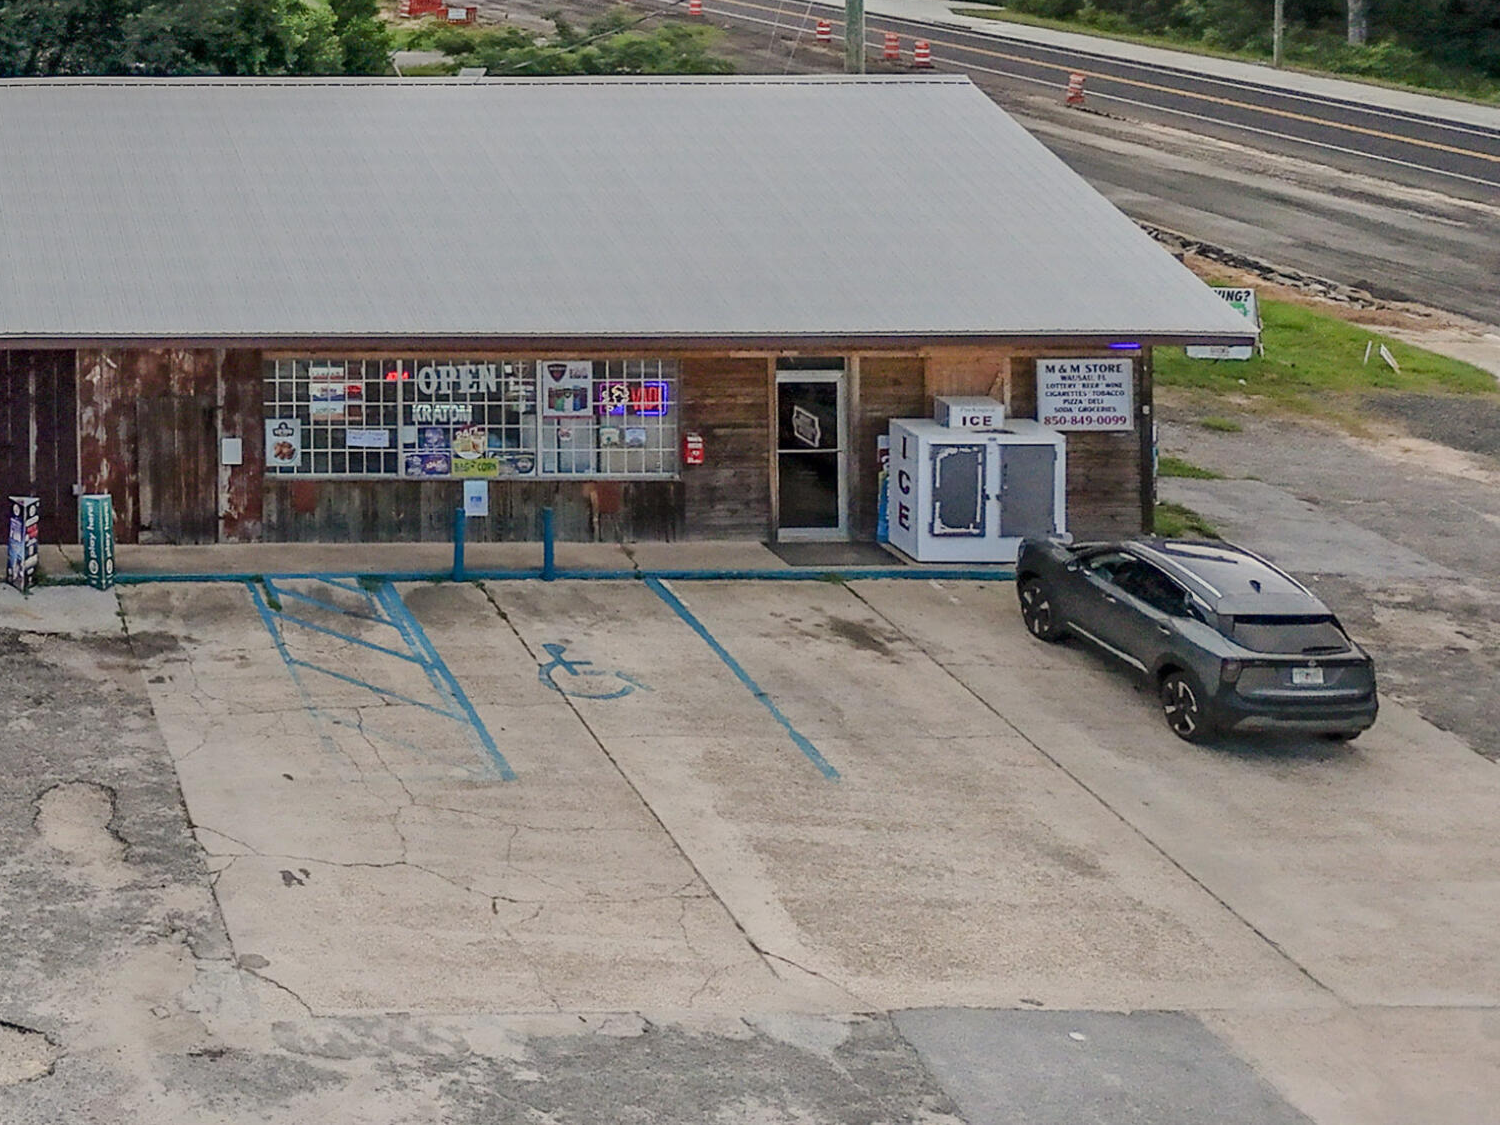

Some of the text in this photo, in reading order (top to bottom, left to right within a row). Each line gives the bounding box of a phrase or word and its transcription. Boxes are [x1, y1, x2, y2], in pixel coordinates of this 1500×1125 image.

[1045, 364, 1123, 374] M & M STORE
[418, 364, 497, 395] OPEN
[411, 404, 473, 423] KRATOM
[962, 416, 992, 426] ICE
[1043, 415, 1127, 426] 850-849-0099
[898, 435, 911, 532] ICE
[86, 501, 98, 559] play here!
